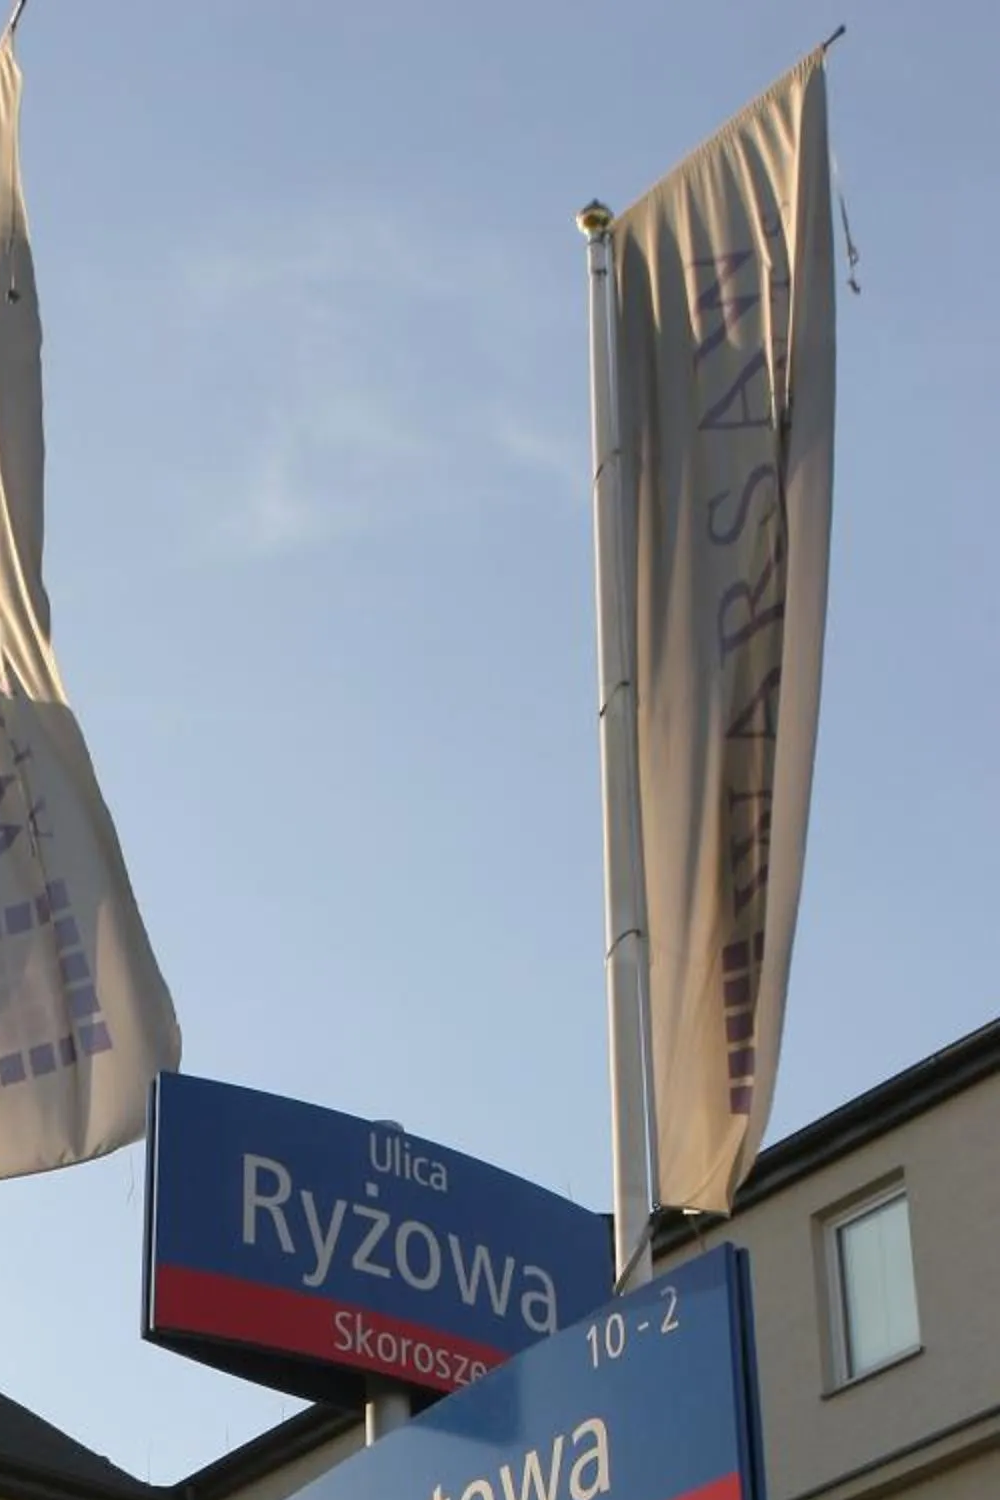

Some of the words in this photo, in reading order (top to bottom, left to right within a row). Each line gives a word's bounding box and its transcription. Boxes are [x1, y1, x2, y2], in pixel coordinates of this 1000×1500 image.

[369, 1132, 448, 1193] Ulica
[241, 1152, 558, 1335] Ryżowa
[334, 1311, 488, 1386] Skorosze
[586, 1312, 625, 1368] 10
[660, 1285, 679, 1333] 2
